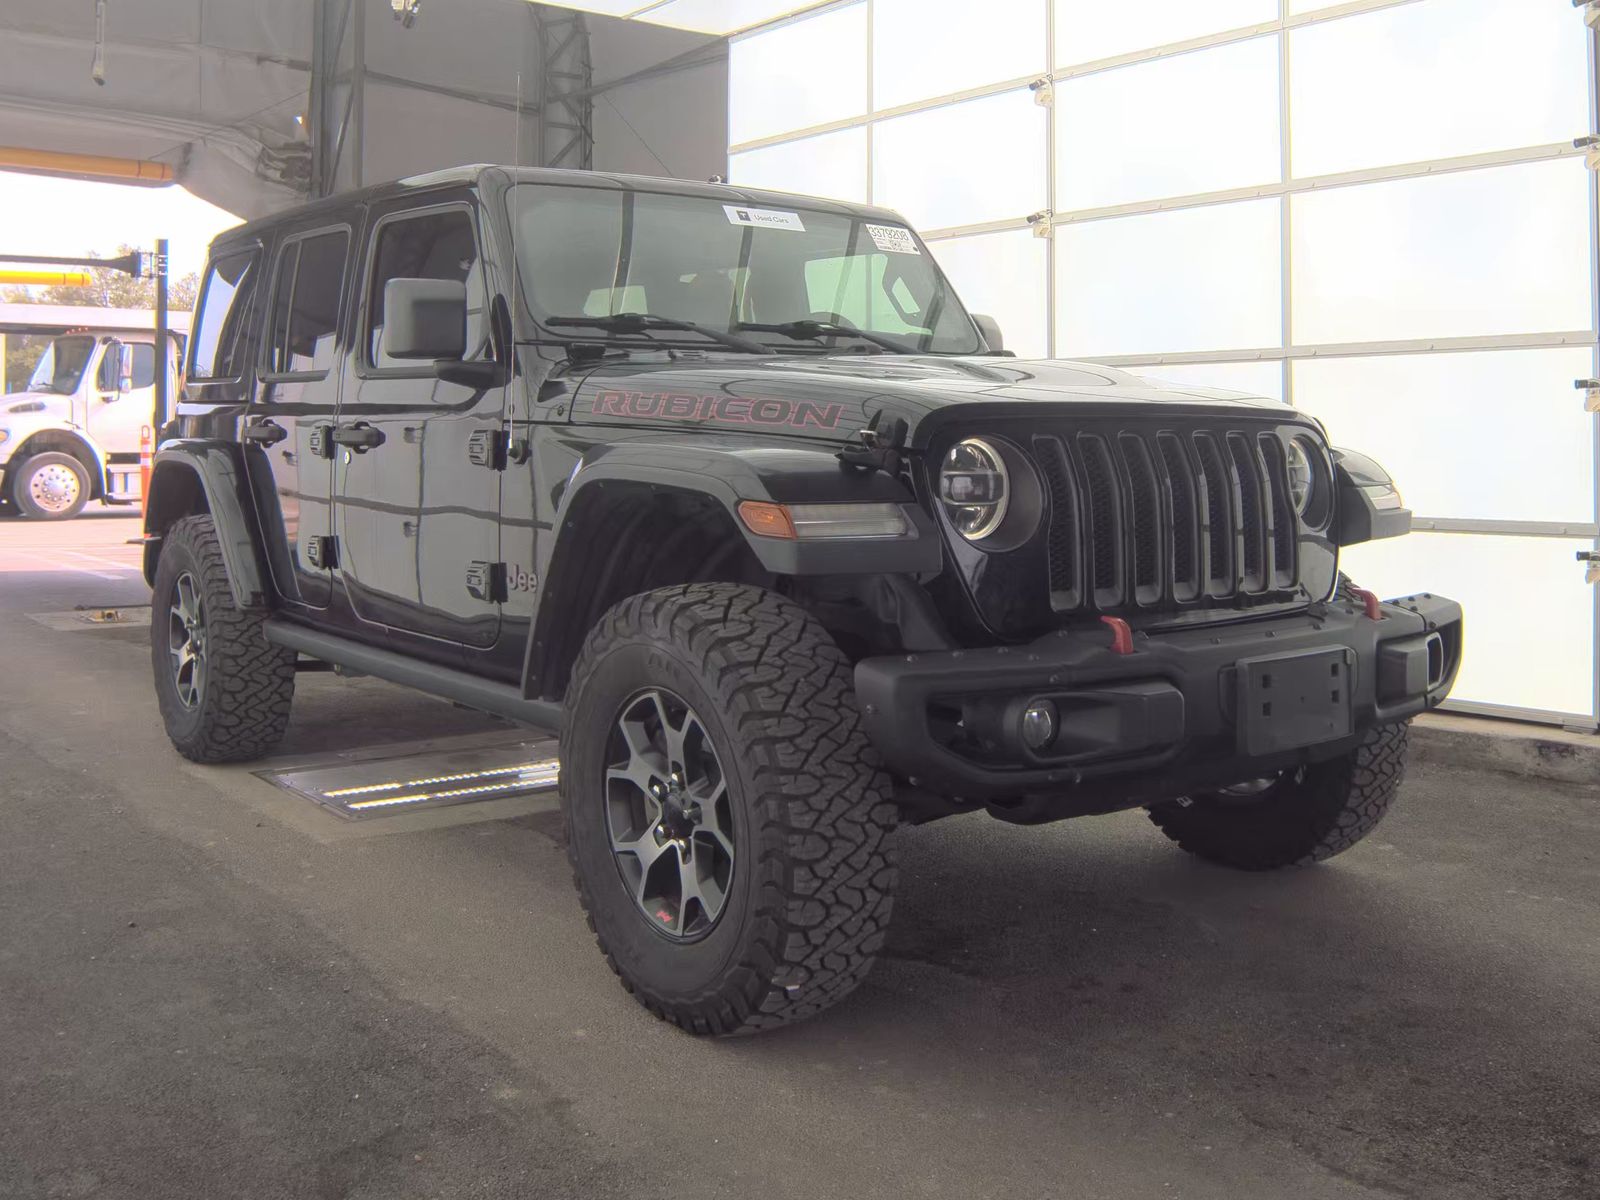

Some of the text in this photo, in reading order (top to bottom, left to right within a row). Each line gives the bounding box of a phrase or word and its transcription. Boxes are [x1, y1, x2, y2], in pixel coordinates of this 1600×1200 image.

[753, 213, 772, 222] Used
[773, 215, 789, 224] Cars
[592, 390, 845, 430] RUBICON
[506, 564, 538, 593] Jee
